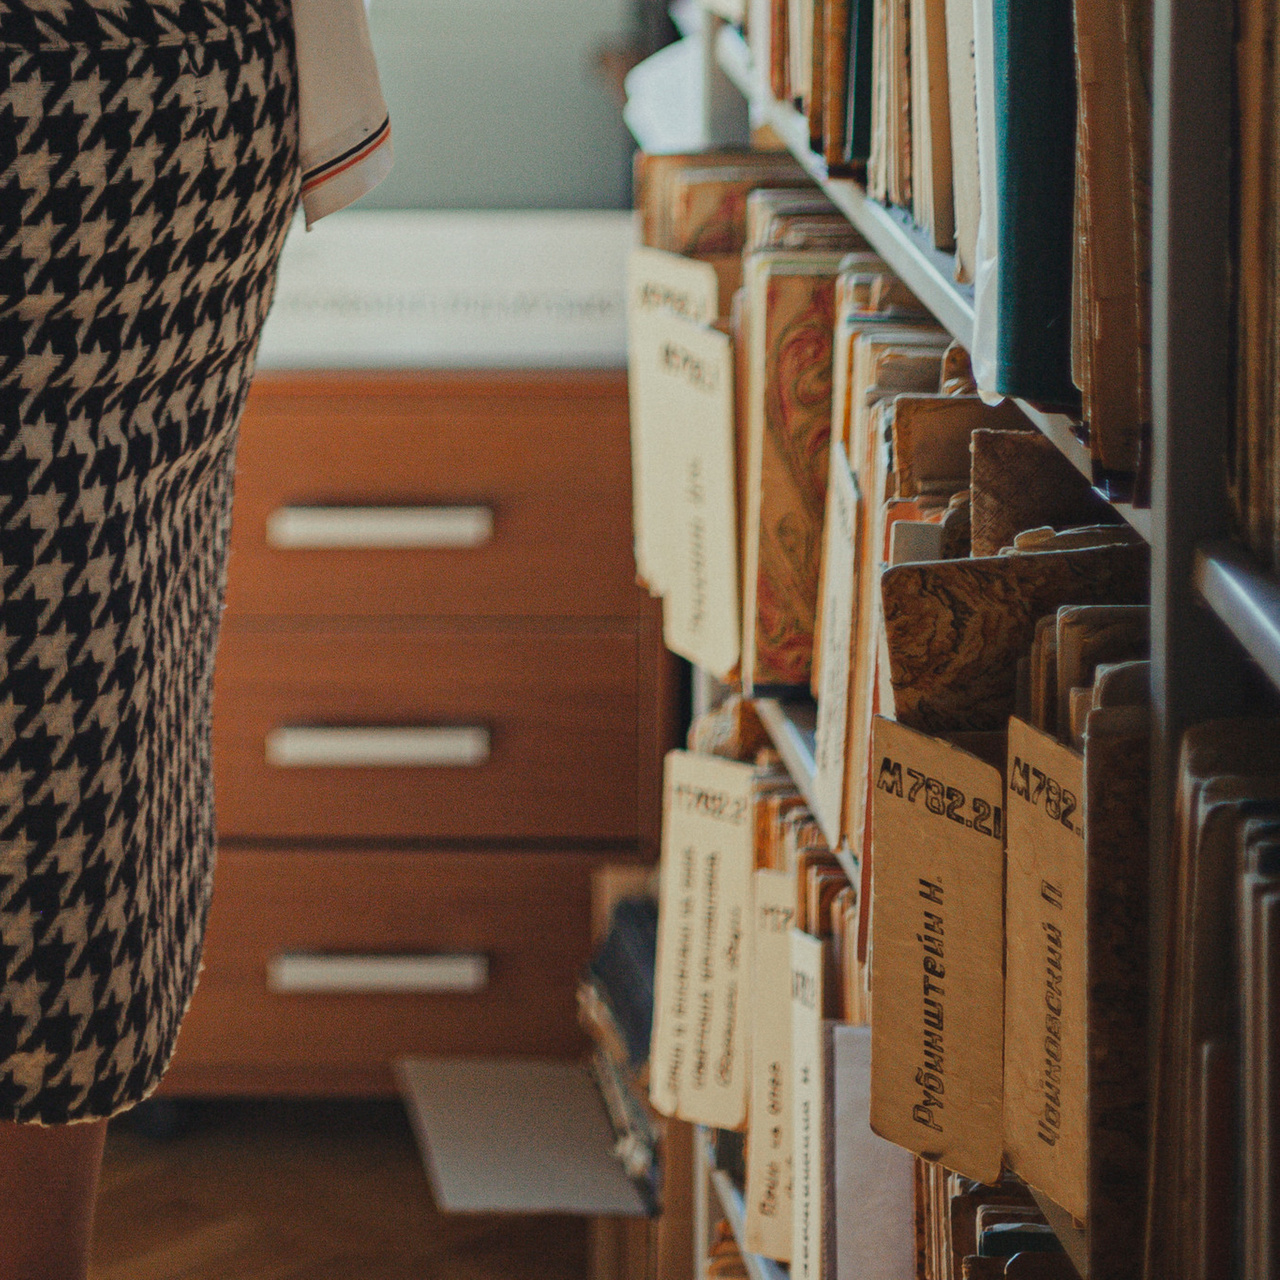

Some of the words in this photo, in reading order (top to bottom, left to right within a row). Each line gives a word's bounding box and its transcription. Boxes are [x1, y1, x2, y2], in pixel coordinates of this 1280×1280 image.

[1009, 756, 1086, 839] М782.
[912, 911, 946, 1132] Рубинштейн
[1036, 921, 1063, 1147] Чайковский
